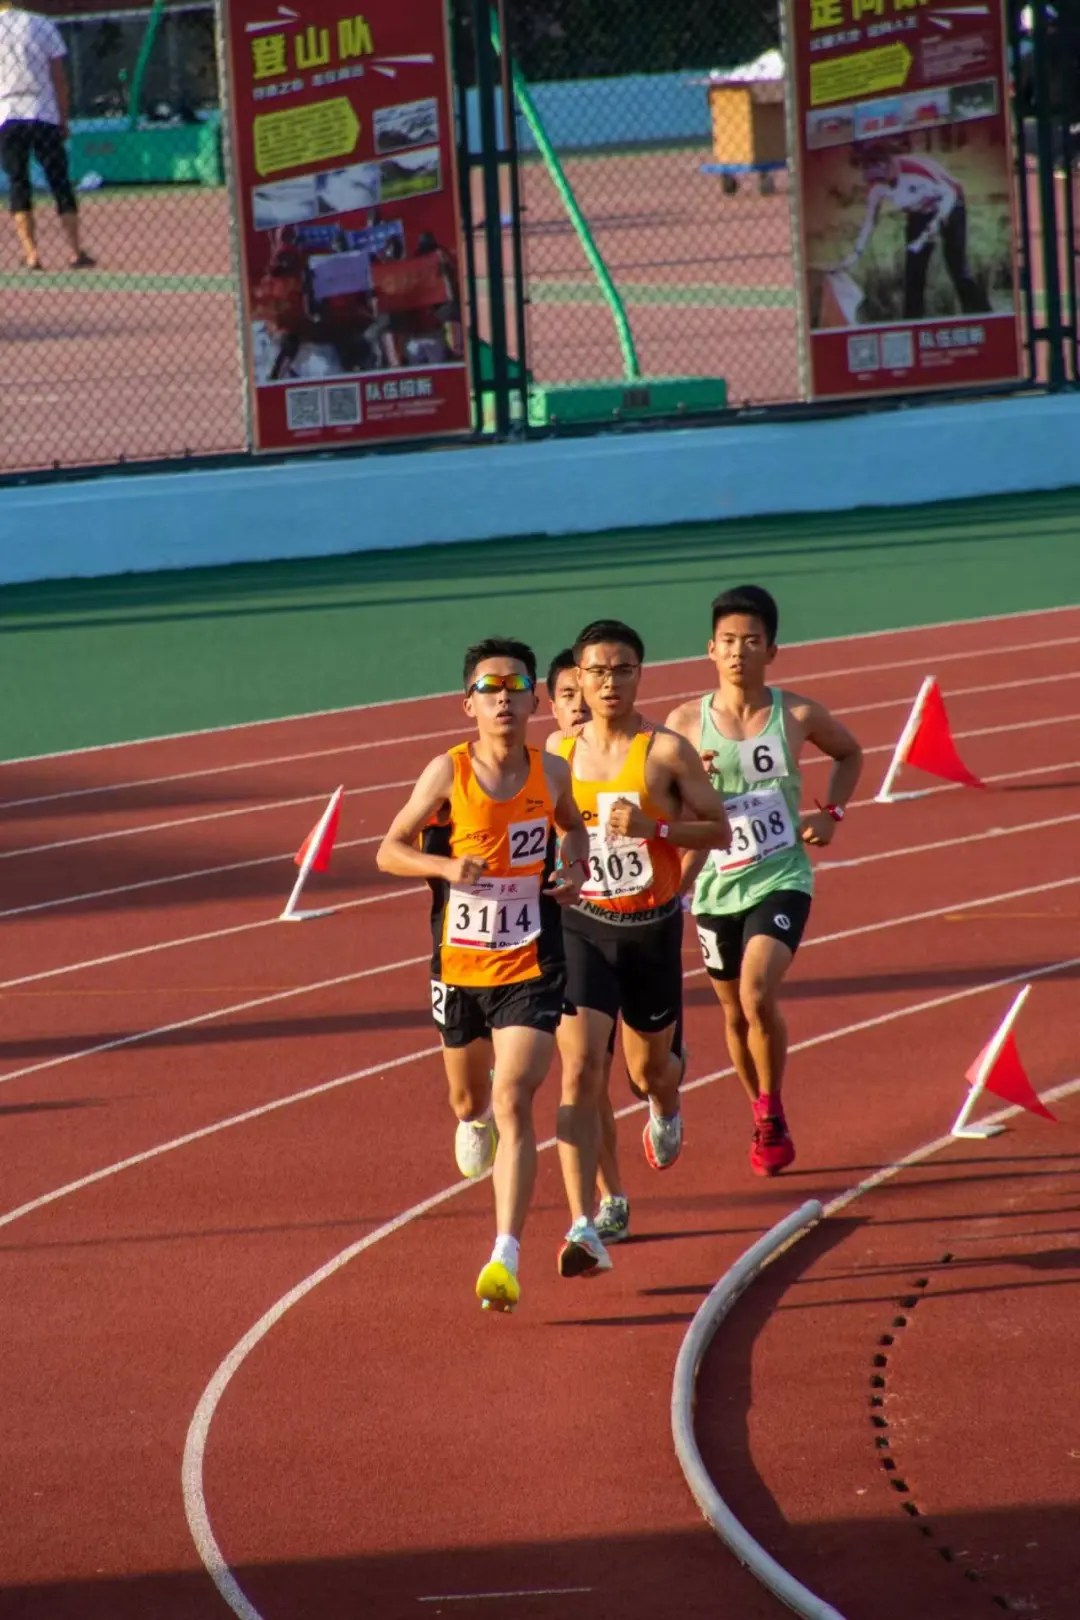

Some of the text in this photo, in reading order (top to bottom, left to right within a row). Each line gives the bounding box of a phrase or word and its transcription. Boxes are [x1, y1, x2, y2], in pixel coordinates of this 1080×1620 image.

[252, 15, 374, 79] 登山队
[753, 745, 774, 773] 6
[511, 826, 546, 859] 22
[726, 810, 785, 856] 308
[589, 851, 643, 883] 303
[456, 903, 532, 934] 3114
